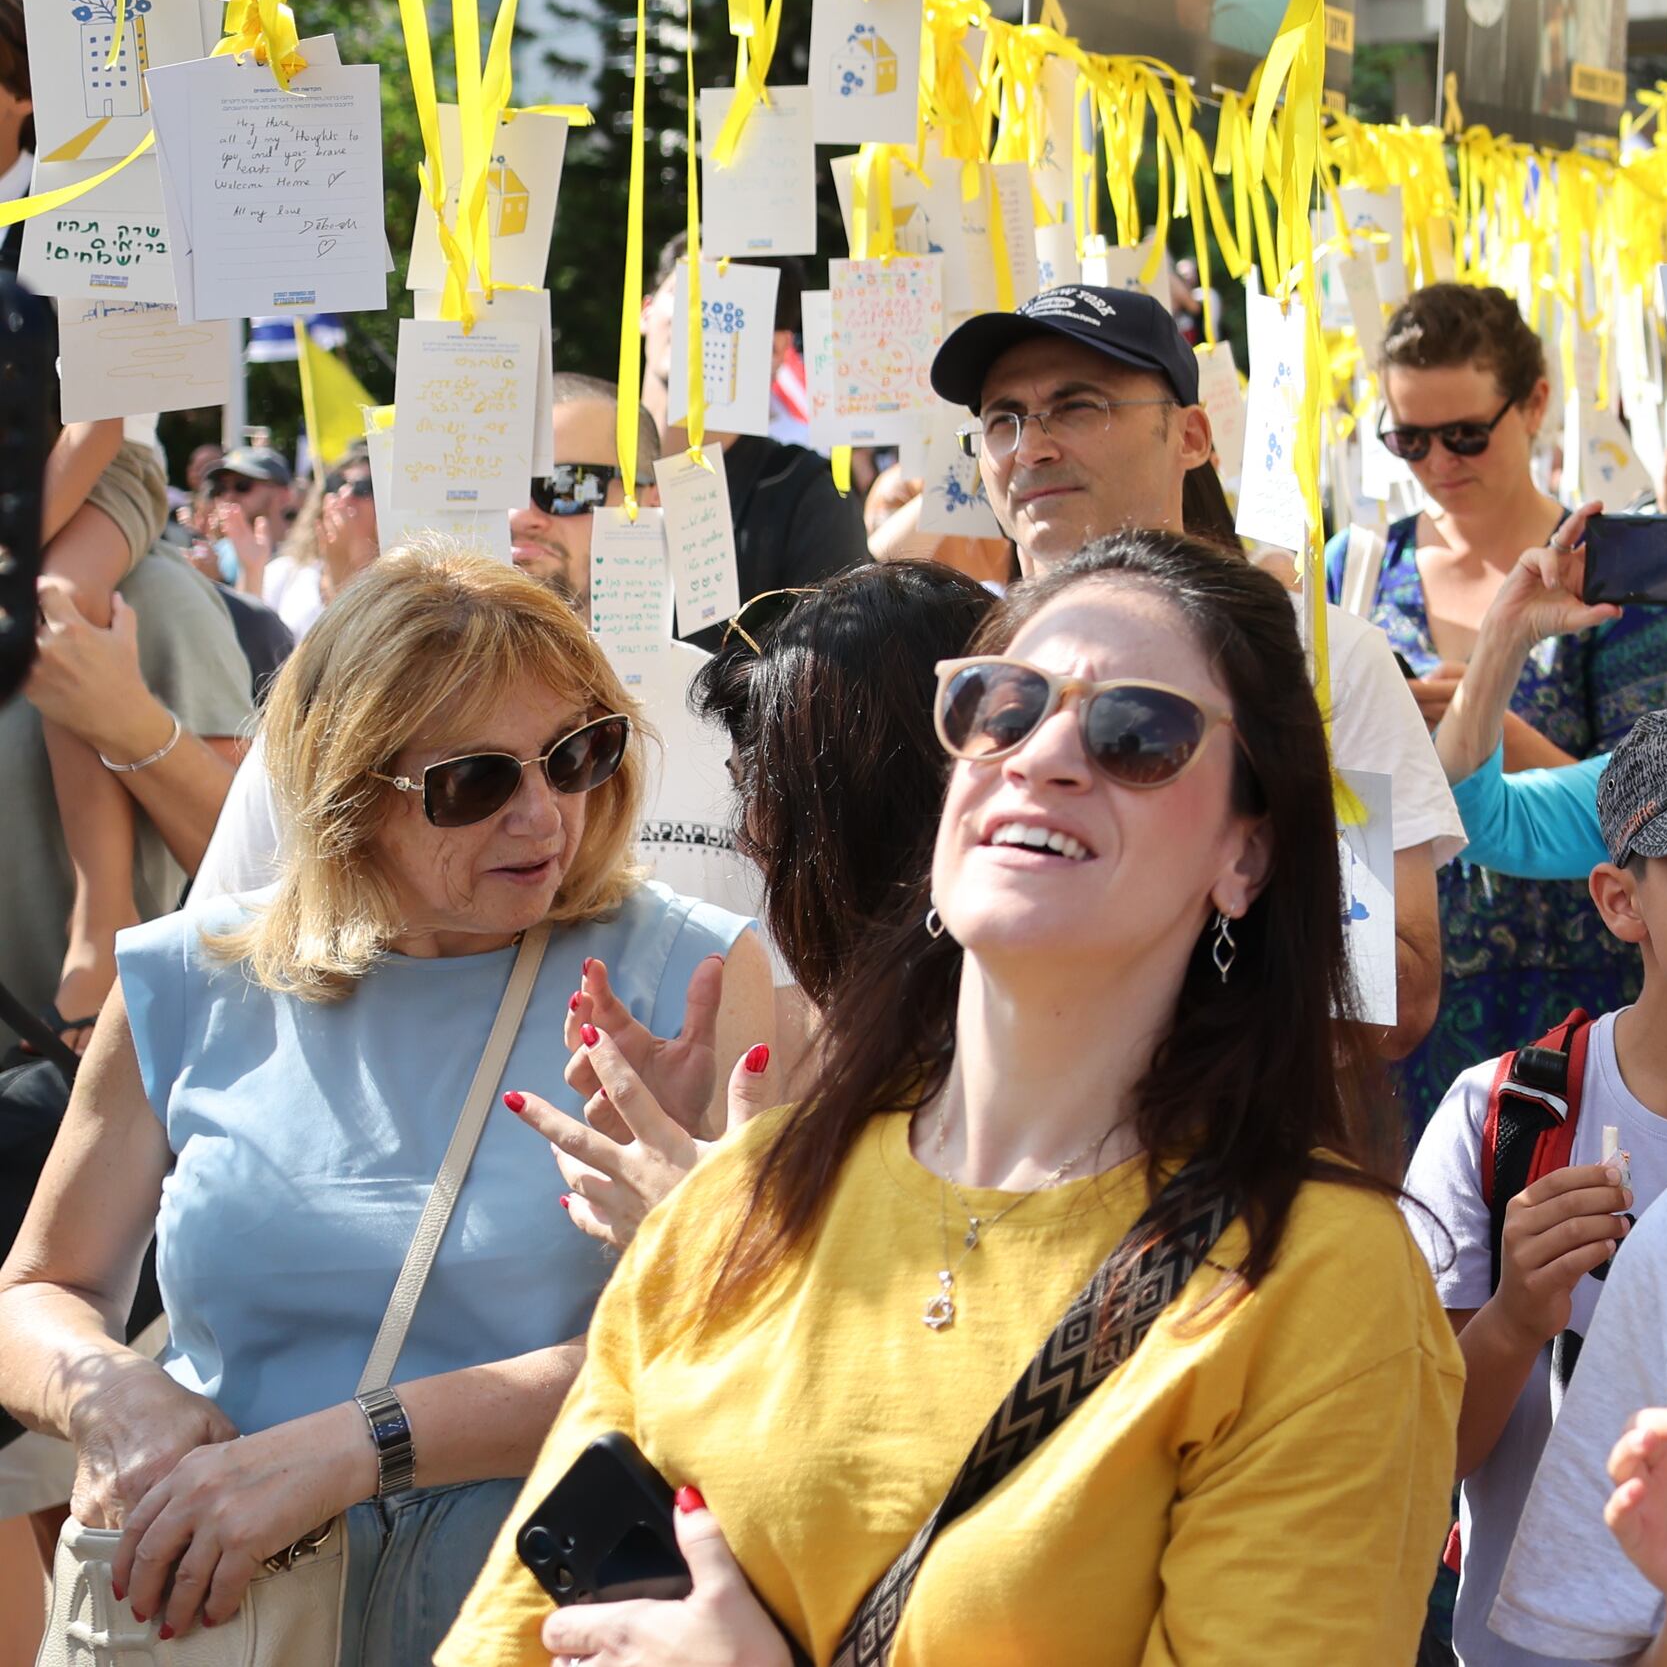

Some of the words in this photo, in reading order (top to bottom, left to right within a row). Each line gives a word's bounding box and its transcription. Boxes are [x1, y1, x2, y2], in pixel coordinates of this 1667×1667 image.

[219, 134, 236, 144] all
[349, 130, 359, 141] to
[215, 179, 263, 190] Welcome
[277, 178, 310, 187] Home
